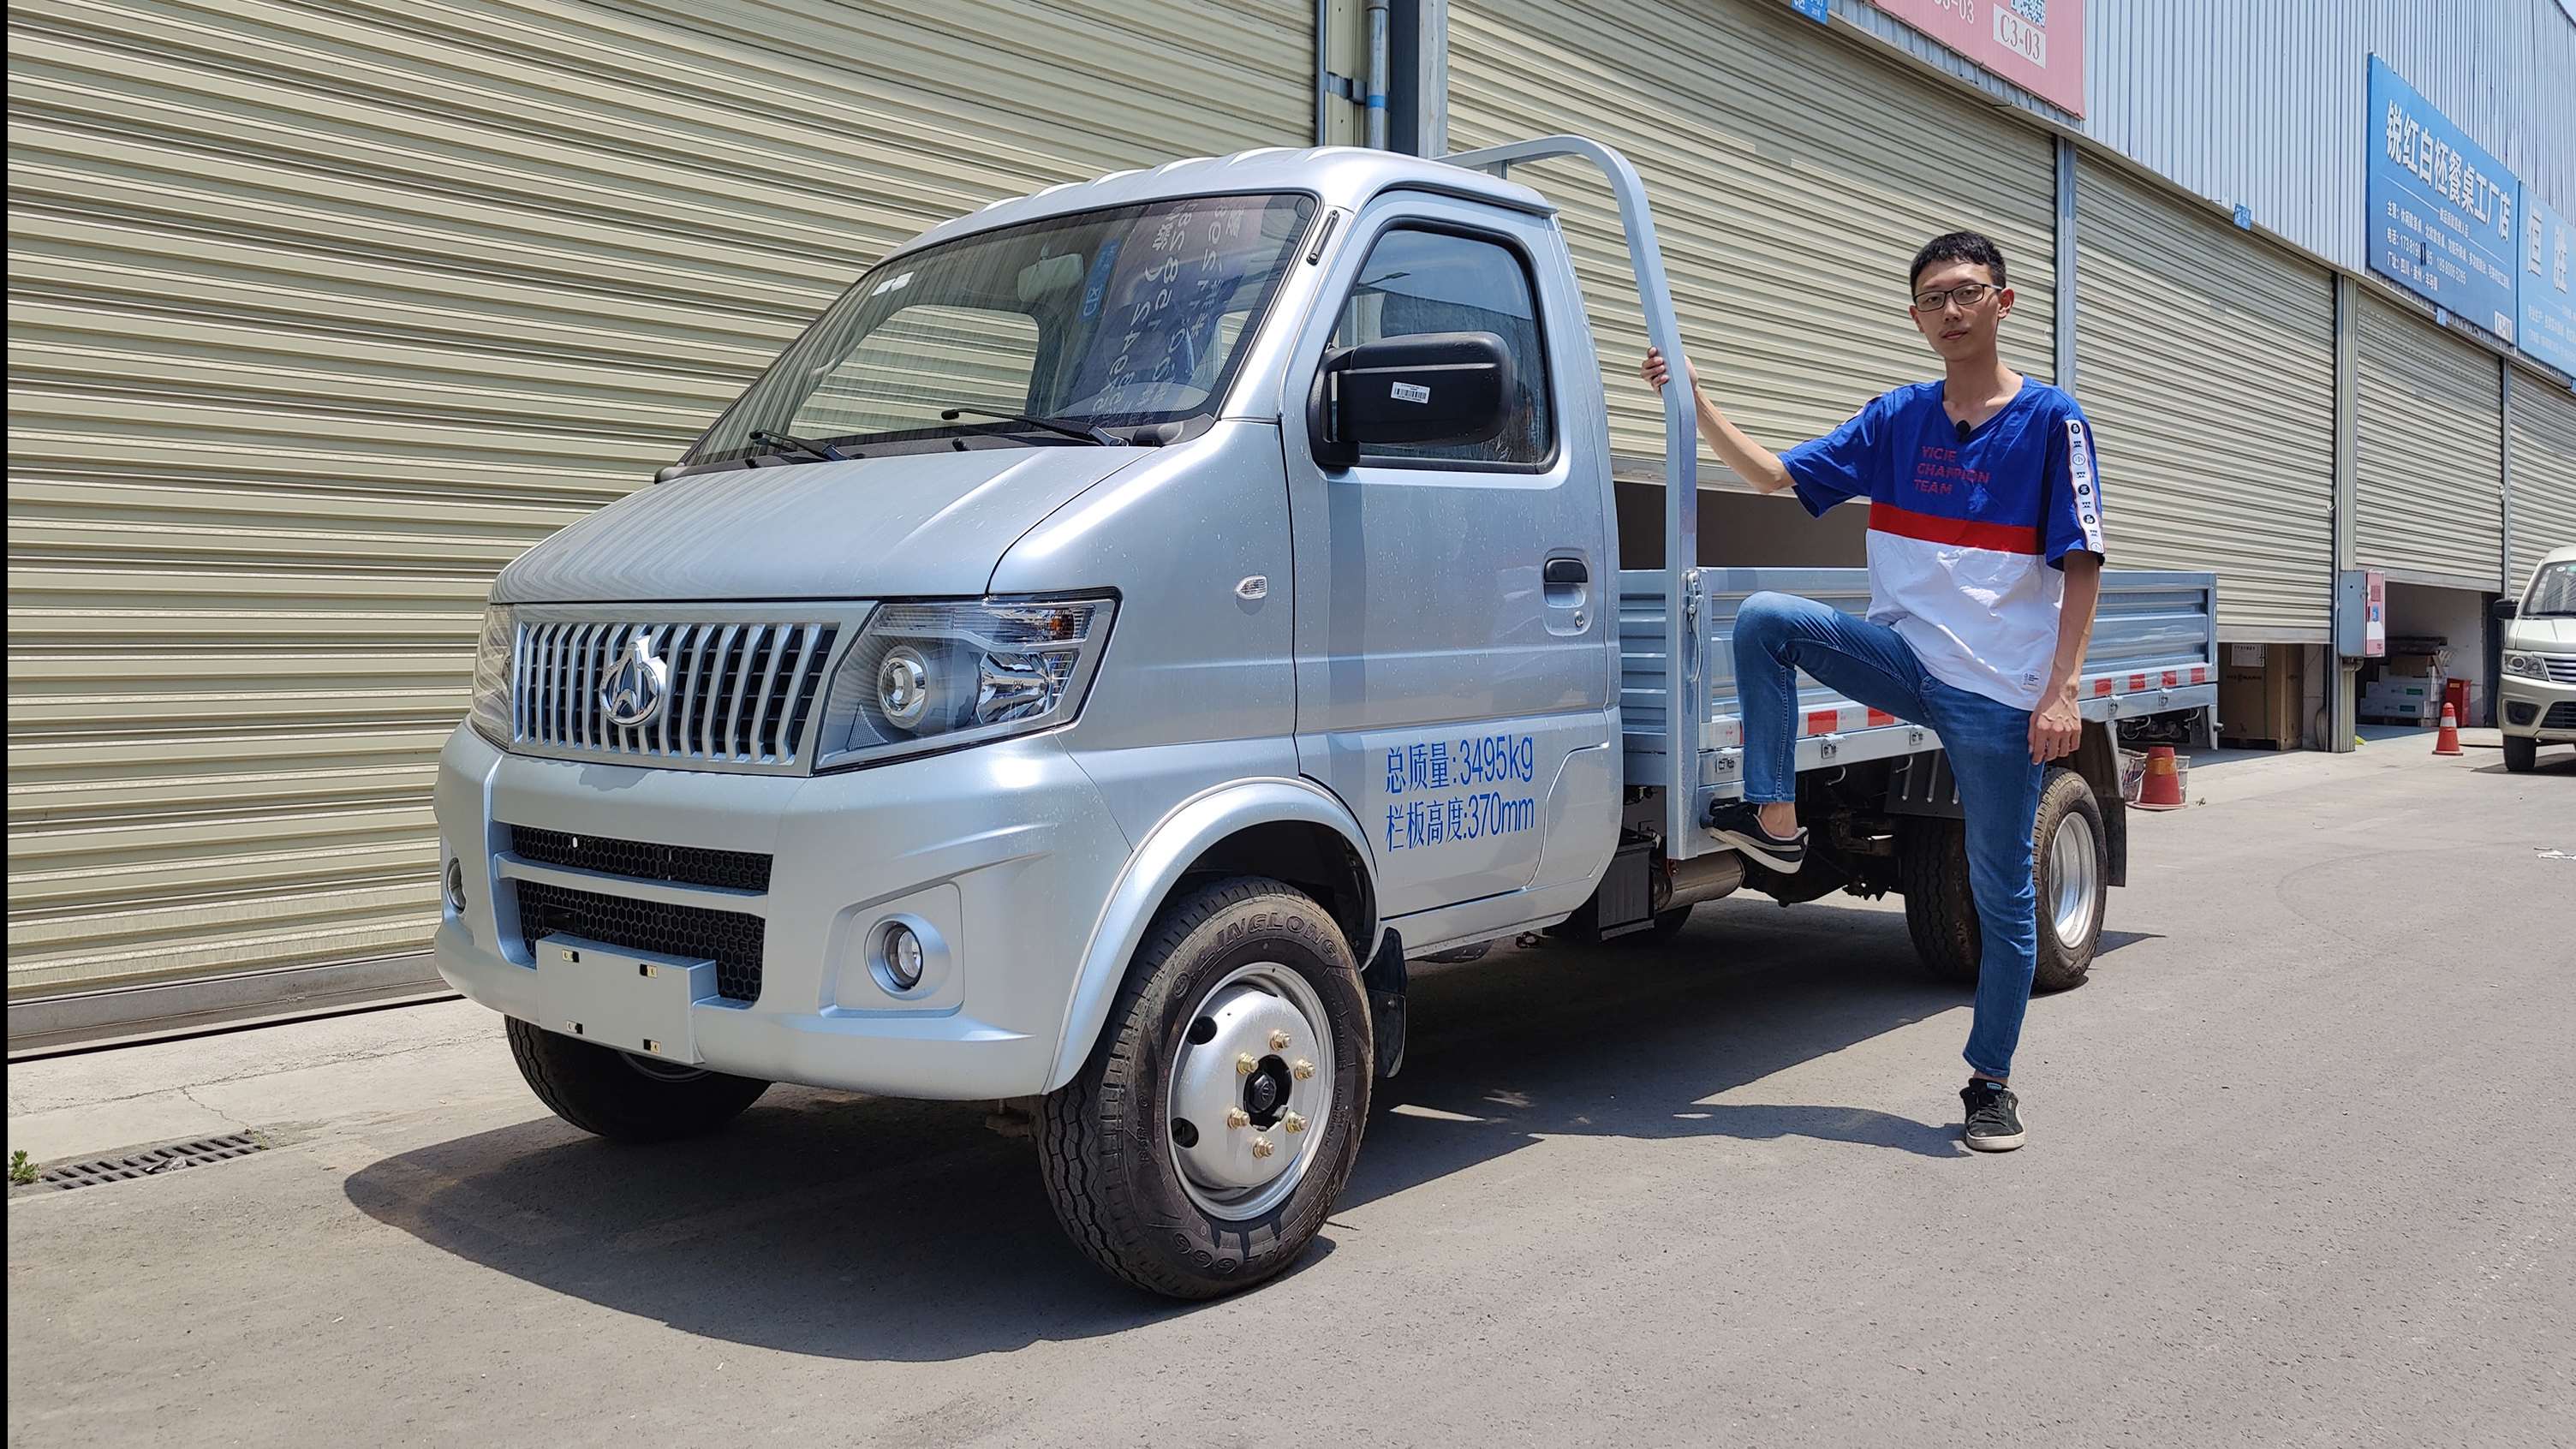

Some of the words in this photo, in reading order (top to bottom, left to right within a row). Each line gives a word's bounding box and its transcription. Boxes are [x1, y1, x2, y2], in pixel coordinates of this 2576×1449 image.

[2000, 14, 2040, 60] C3-03
[1913, 479, 1953, 494] TEAM
[1385, 734, 1534, 794] 总质量:3495kg
[1386, 790, 1535, 853] 栏板高度:370mm
